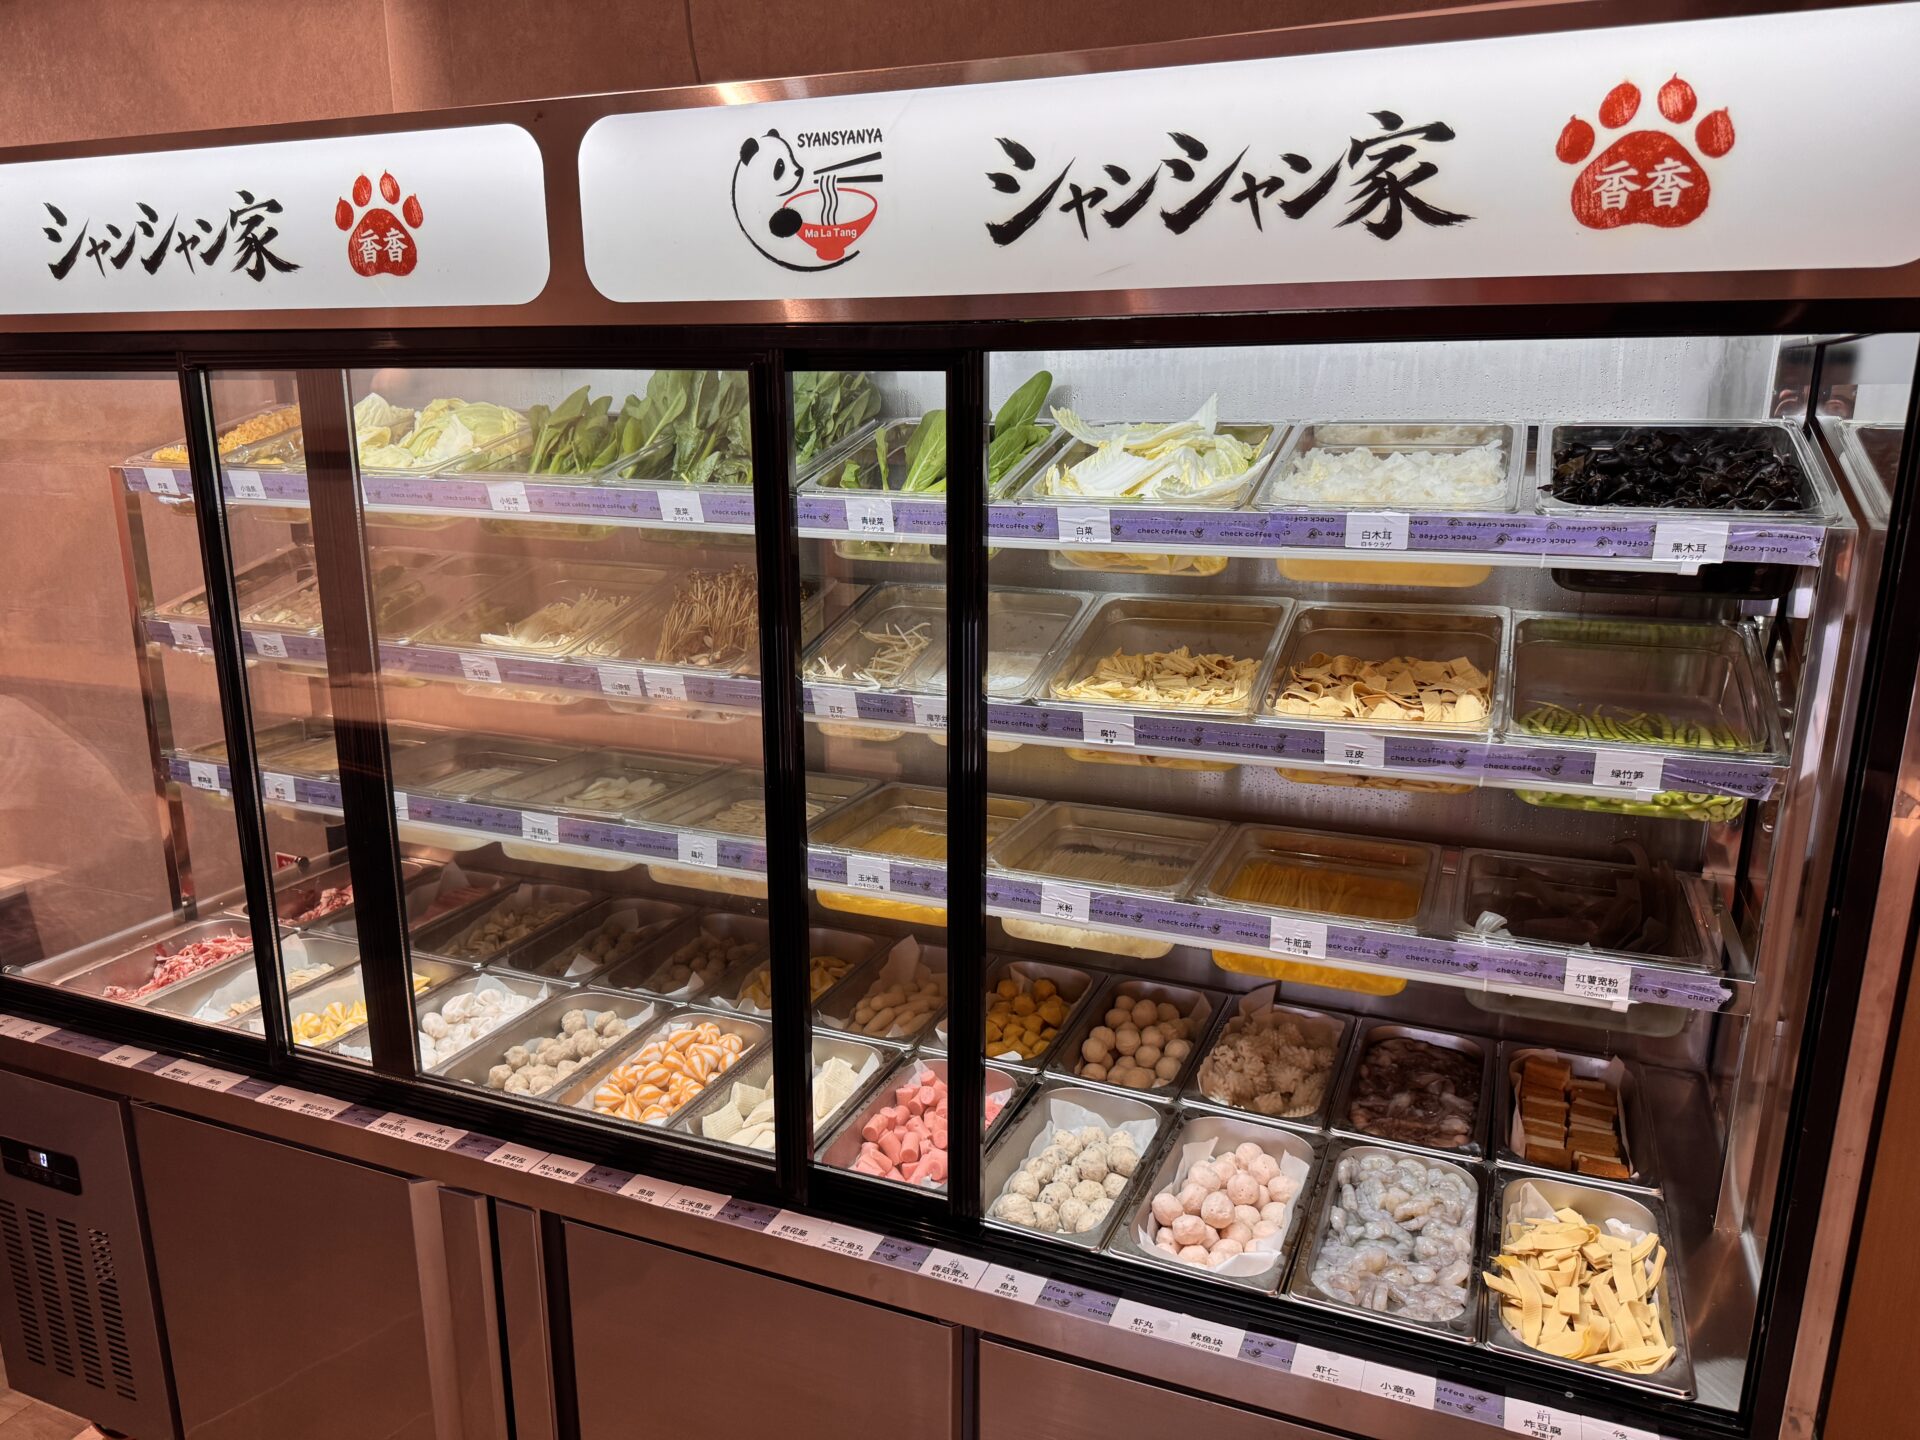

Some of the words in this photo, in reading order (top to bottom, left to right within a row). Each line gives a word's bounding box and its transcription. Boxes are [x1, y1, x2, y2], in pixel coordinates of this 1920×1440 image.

[797, 128, 883, 148] SYANSYANYA
[985, 110, 1478, 247] シャンシャン家
[1591, 156, 1694, 211] 香香
[42, 190, 303, 282] シャンシャン家
[804, 228, 819, 239] Ma
[820, 228, 832, 238] La
[833, 227, 857, 239] Tang
[358, 228, 408, 264] 香香
[499, 497, 519, 505] 小松菜
[861, 516, 884, 526] 青梗菜
[1005, 523, 1029, 531] coffee
[1075, 527, 1094, 536] 白菜
[1137, 527, 1159, 535] check
[1161, 528, 1187, 536] coffee
[1219, 530, 1243, 538] check
[1244, 530, 1272, 538] coffee
[1361, 530, 1393, 540] 白木耳
[1418, 533, 1449, 542] coffee
[1448, 534, 1478, 542] check
[1515, 536, 1547, 544] coffee
[1548, 537, 1577, 545] check
[1616, 540, 1649, 548] coffee
[1671, 543, 1708, 554] 黑木耳
[1758, 544, 1788, 554] check
[829, 705, 844, 714] 豆芽
[989, 718, 1008, 726] check
[1009, 720, 1034, 728] coffee
[1062, 725, 1083, 733] check
[1100, 729, 1117, 738] 腐竹
[1161, 735, 1186, 743] coffee
[1217, 740, 1240, 748] check
[1241, 741, 1268, 749] coffee
[1344, 749, 1365, 759] 豆皮
[1390, 754, 1416, 763] check
[1417, 756, 1447, 766] coffee
[1483, 762, 1510, 771] check
[1511, 764, 1542, 773] coffee
[1610, 769, 1645, 780] 绿竹笋
[896, 878, 917, 888] coffee
[1011, 896, 1029, 904] check
[1056, 902, 1073, 913] 米粉
[1104, 909, 1128, 919] coffee
[1157, 917, 1179, 927] check
[1181, 921, 1205, 931] coffee
[1236, 929, 1258, 938] check
[1283, 936, 1312, 949] 牛筋面
[1343, 945, 1371, 955] coffee
[1405, 953, 1430, 963] check
[1431, 957, 1461, 968] coffee
[1495, 967, 1522, 977] check
[1523, 970, 1552, 981] coffee
[1687, 992, 1715, 1004] check
[1000, 1282, 1019, 1294] 鱼丸
[1133, 1317, 1154, 1330] 虾丸
[1190, 1332, 1224, 1348] 鱿鱼块
[1315, 1364, 1340, 1378] 虾仁
[1379, 1381, 1416, 1398] 小章鱼
[1523, 1419, 1562, 1437] 炸豆腐
